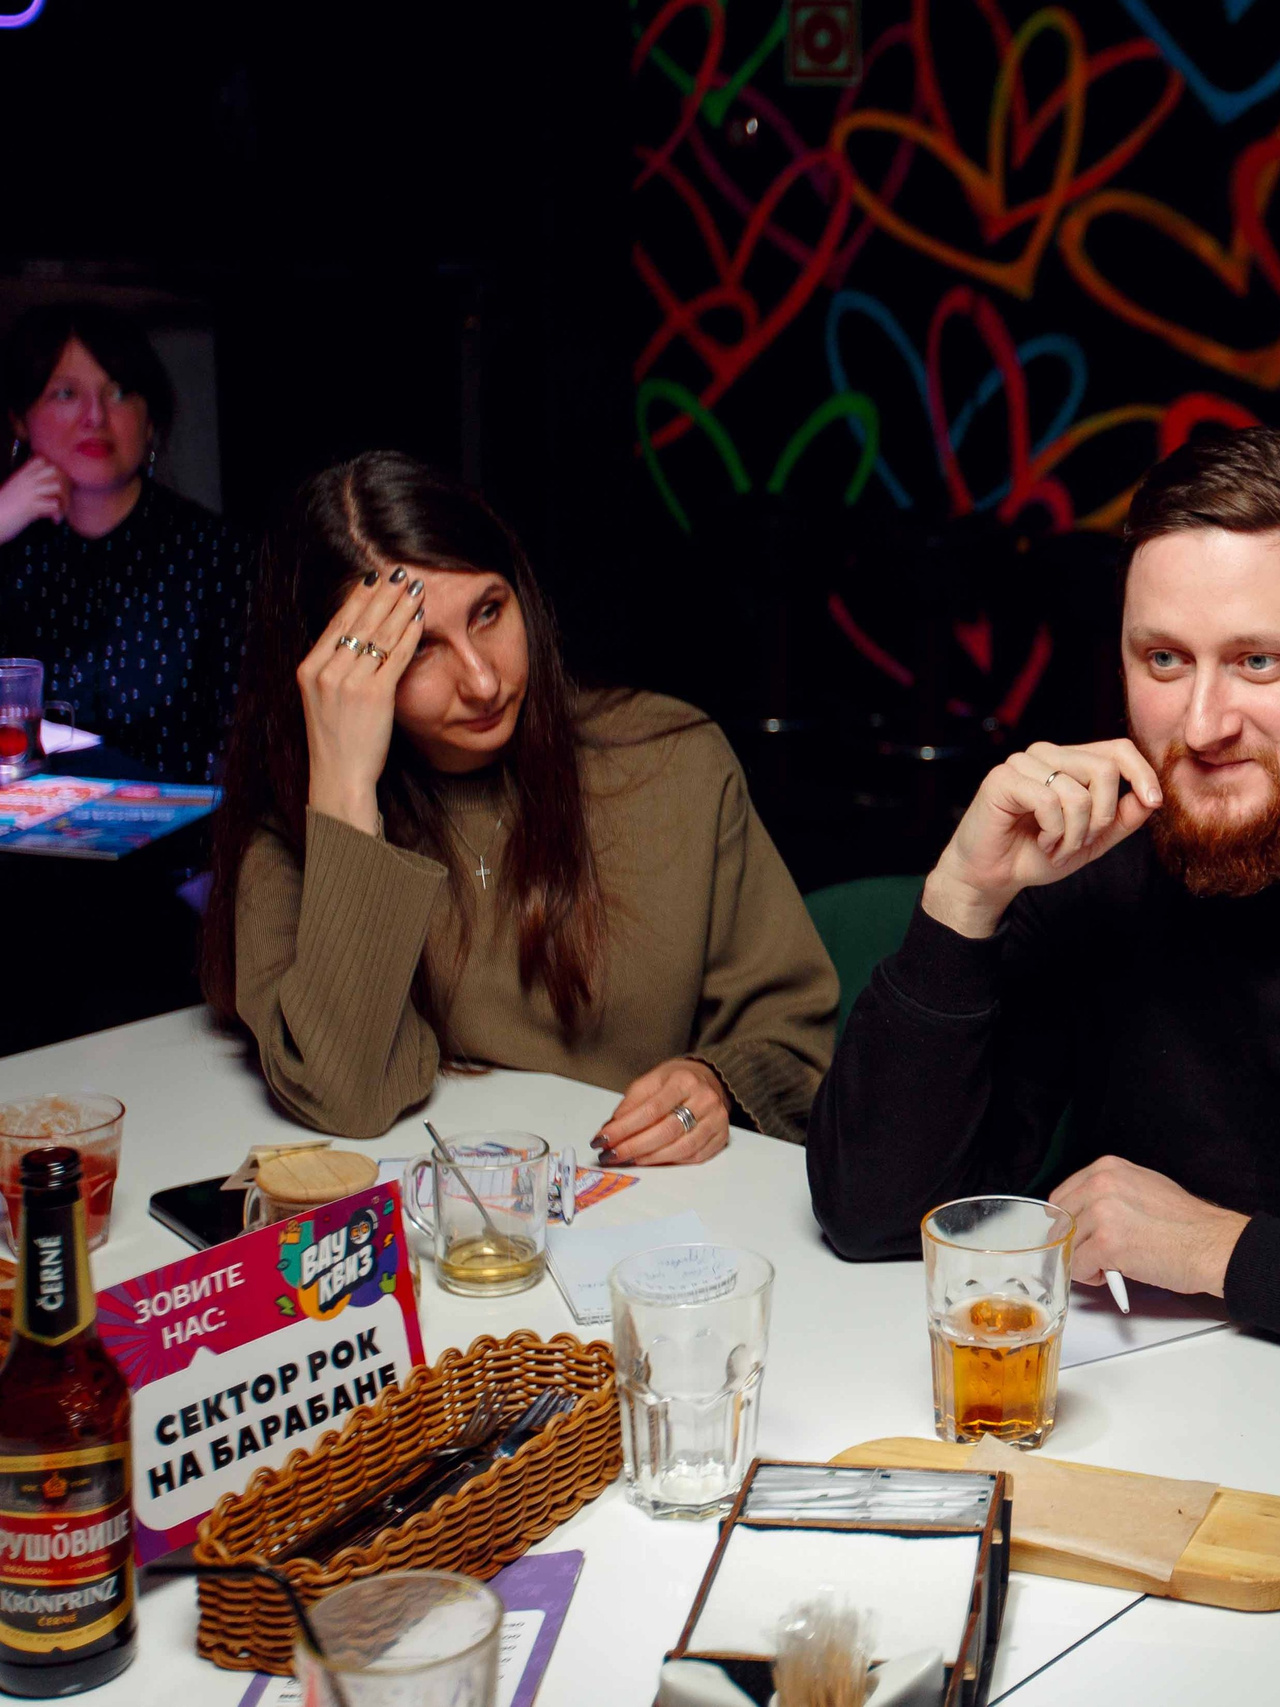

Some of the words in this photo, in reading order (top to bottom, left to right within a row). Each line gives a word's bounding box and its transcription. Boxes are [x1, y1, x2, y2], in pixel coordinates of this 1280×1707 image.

[301, 1228, 348, 1286] ВАУ
[318, 1245, 375, 1306] КВИЗ
[133, 1261, 246, 1325] ЗОВИТЕ
[161, 1306, 228, 1350] НАС:
[154, 1362, 299, 1446] СЕКТОР
[306, 1326, 382, 1384] РОК
[147, 1450, 204, 1500] НА
[209, 1362, 399, 1472] БАРАБАНЕ
